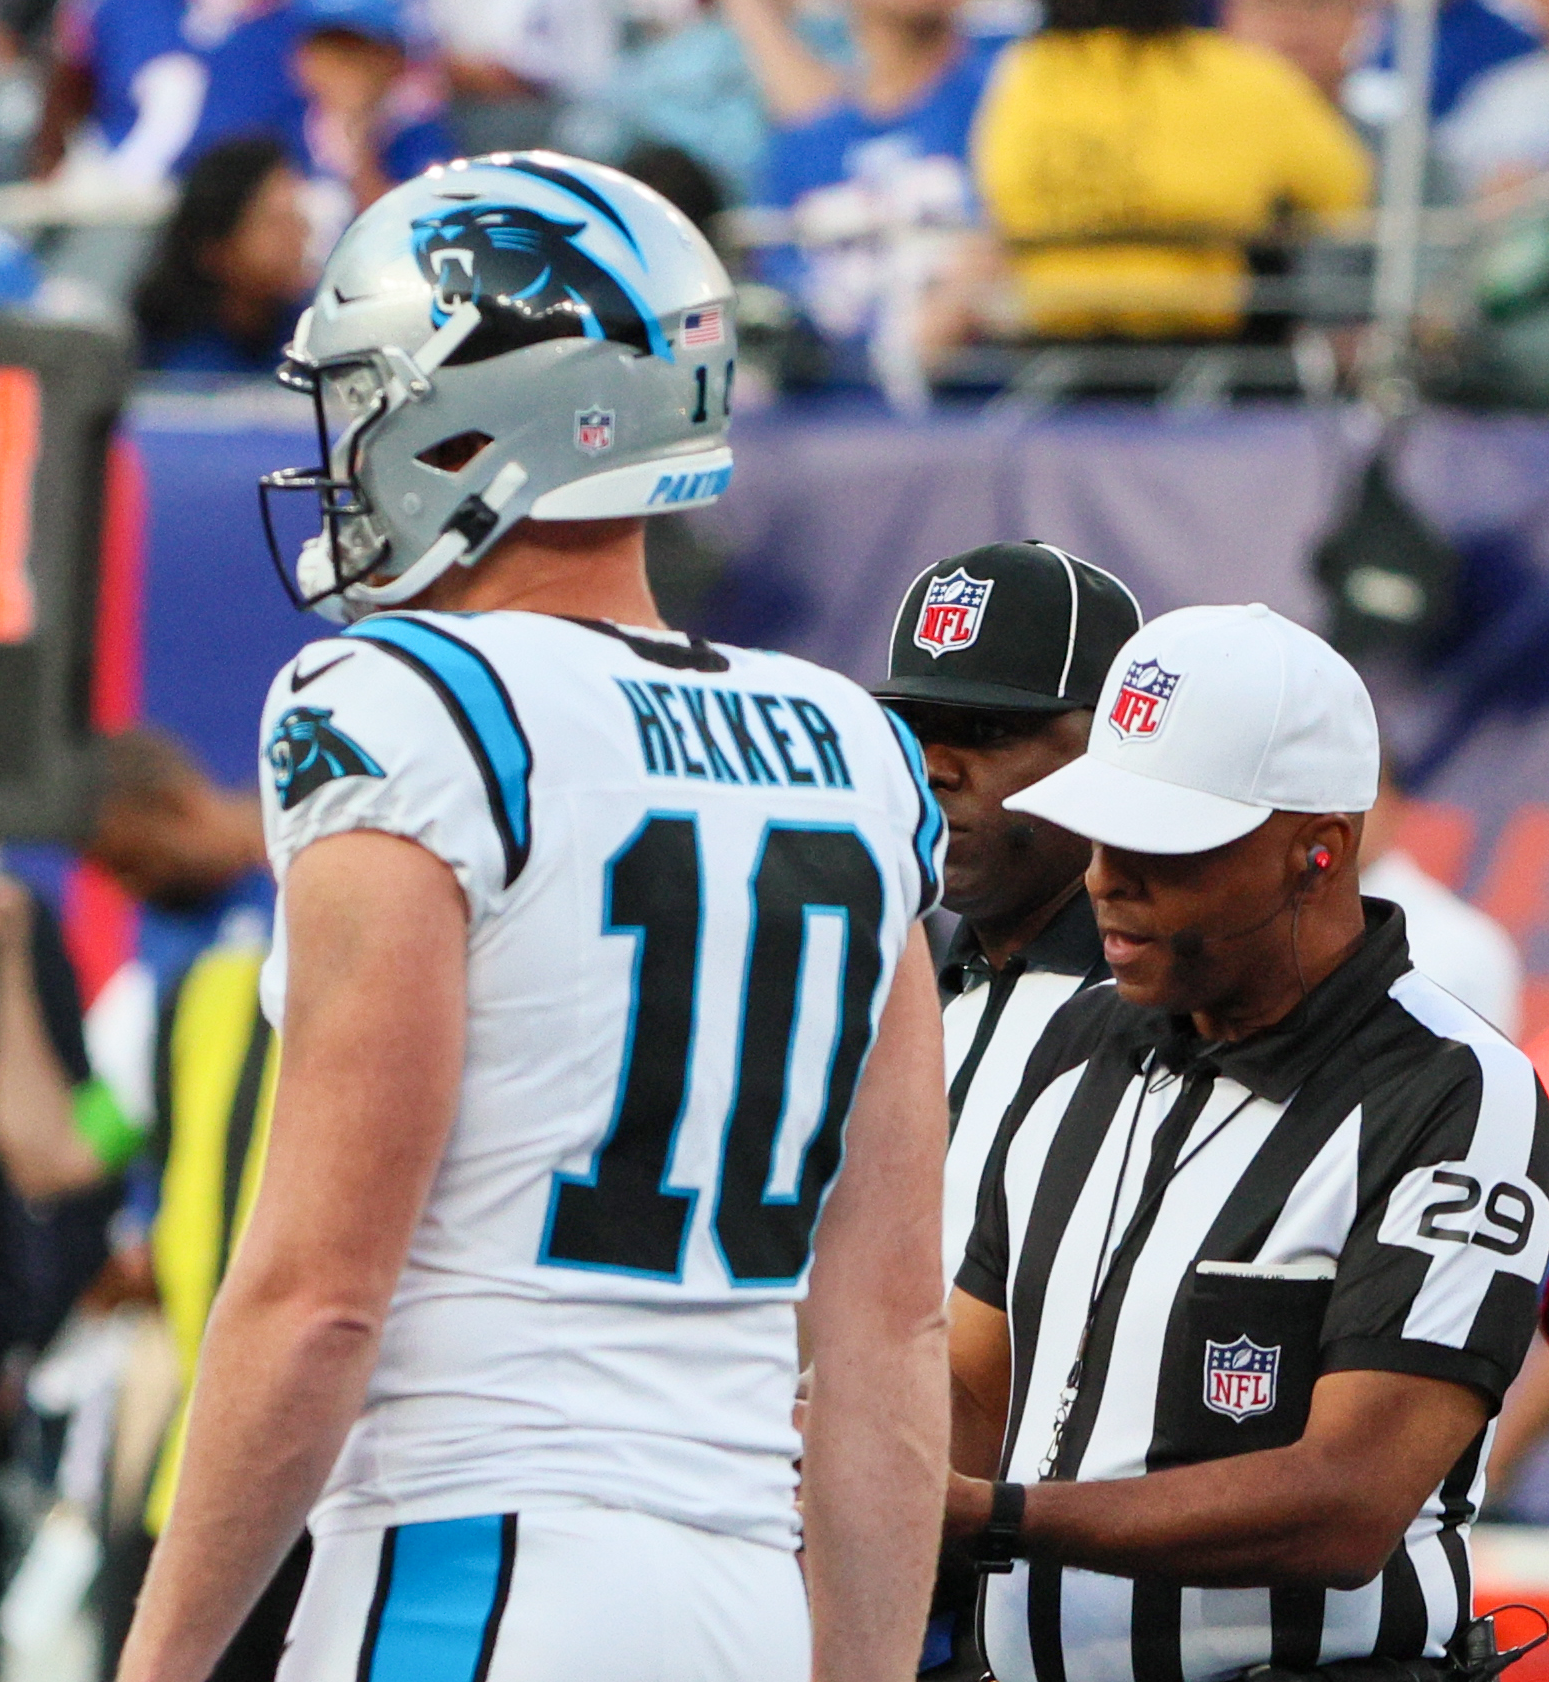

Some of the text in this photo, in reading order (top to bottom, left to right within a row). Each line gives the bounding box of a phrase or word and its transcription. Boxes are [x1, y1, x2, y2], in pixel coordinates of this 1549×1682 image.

[691, 359, 734, 424] 1
[920, 606, 970, 645] NFL
[611, 676, 856, 791] HEKKER
[1110, 690, 1159, 733] NFL
[537, 809, 884, 1287] 10
[1417, 1170, 1535, 1256] 29
[1211, 1372, 1267, 1410] NFL
